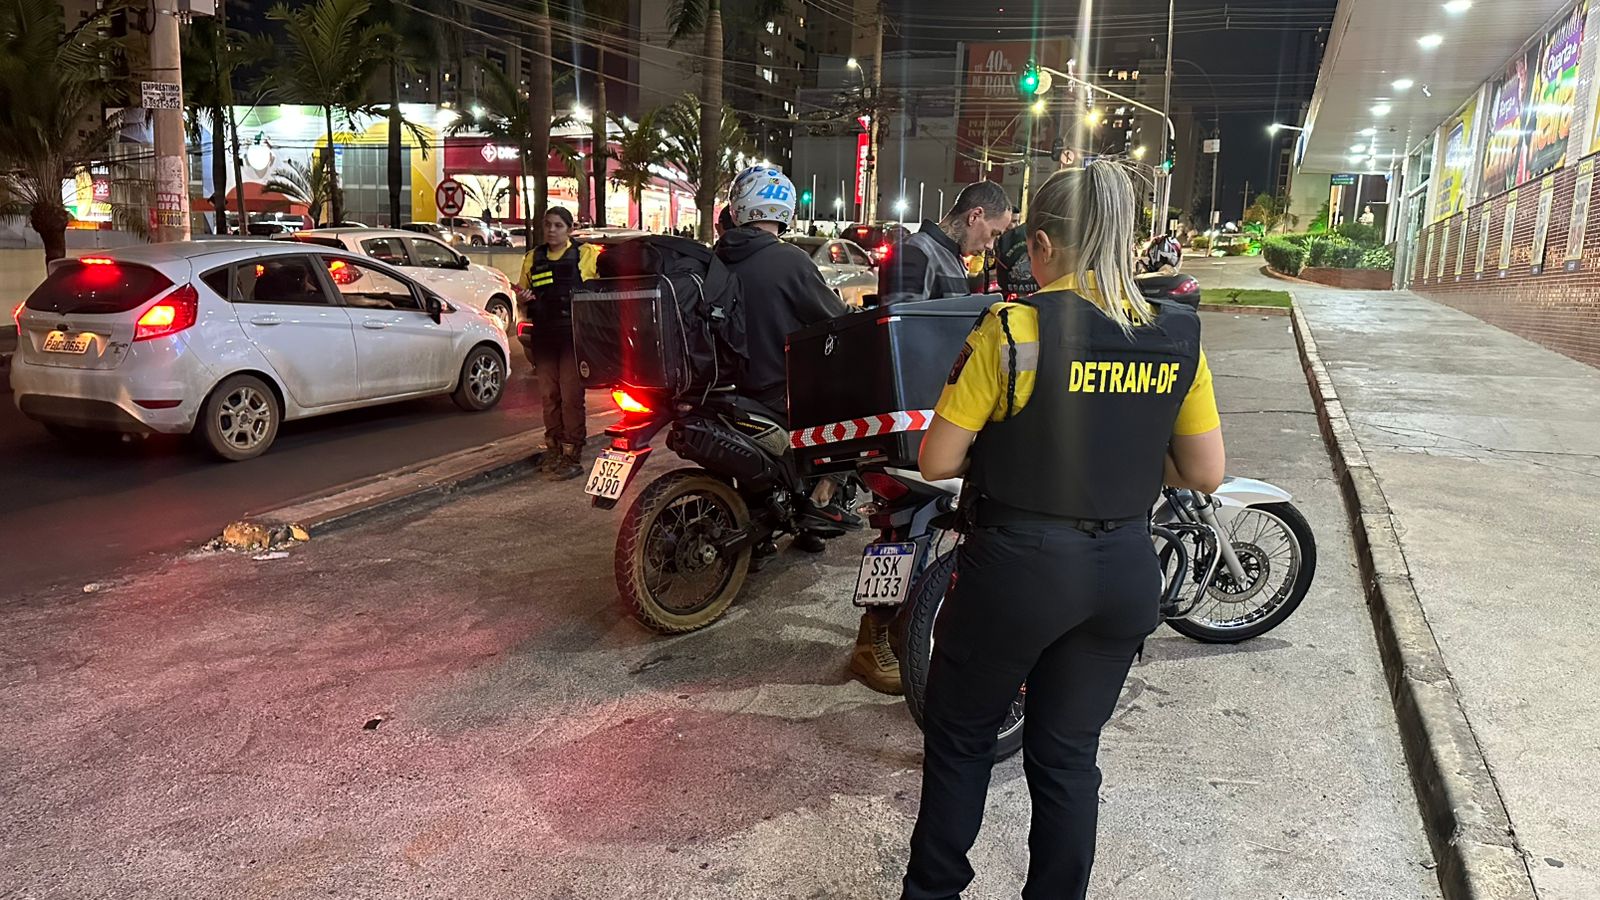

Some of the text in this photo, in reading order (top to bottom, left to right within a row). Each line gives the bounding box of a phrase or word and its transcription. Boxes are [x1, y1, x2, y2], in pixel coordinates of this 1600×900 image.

[756, 184, 790, 201] 46
[1008, 283, 1038, 292] BRASIL
[1068, 361, 1180, 394] DETRAN-DF
[599, 460, 624, 478] SGZ
[590, 475, 621, 495] 9J90
[871, 556, 902, 576] SSK
